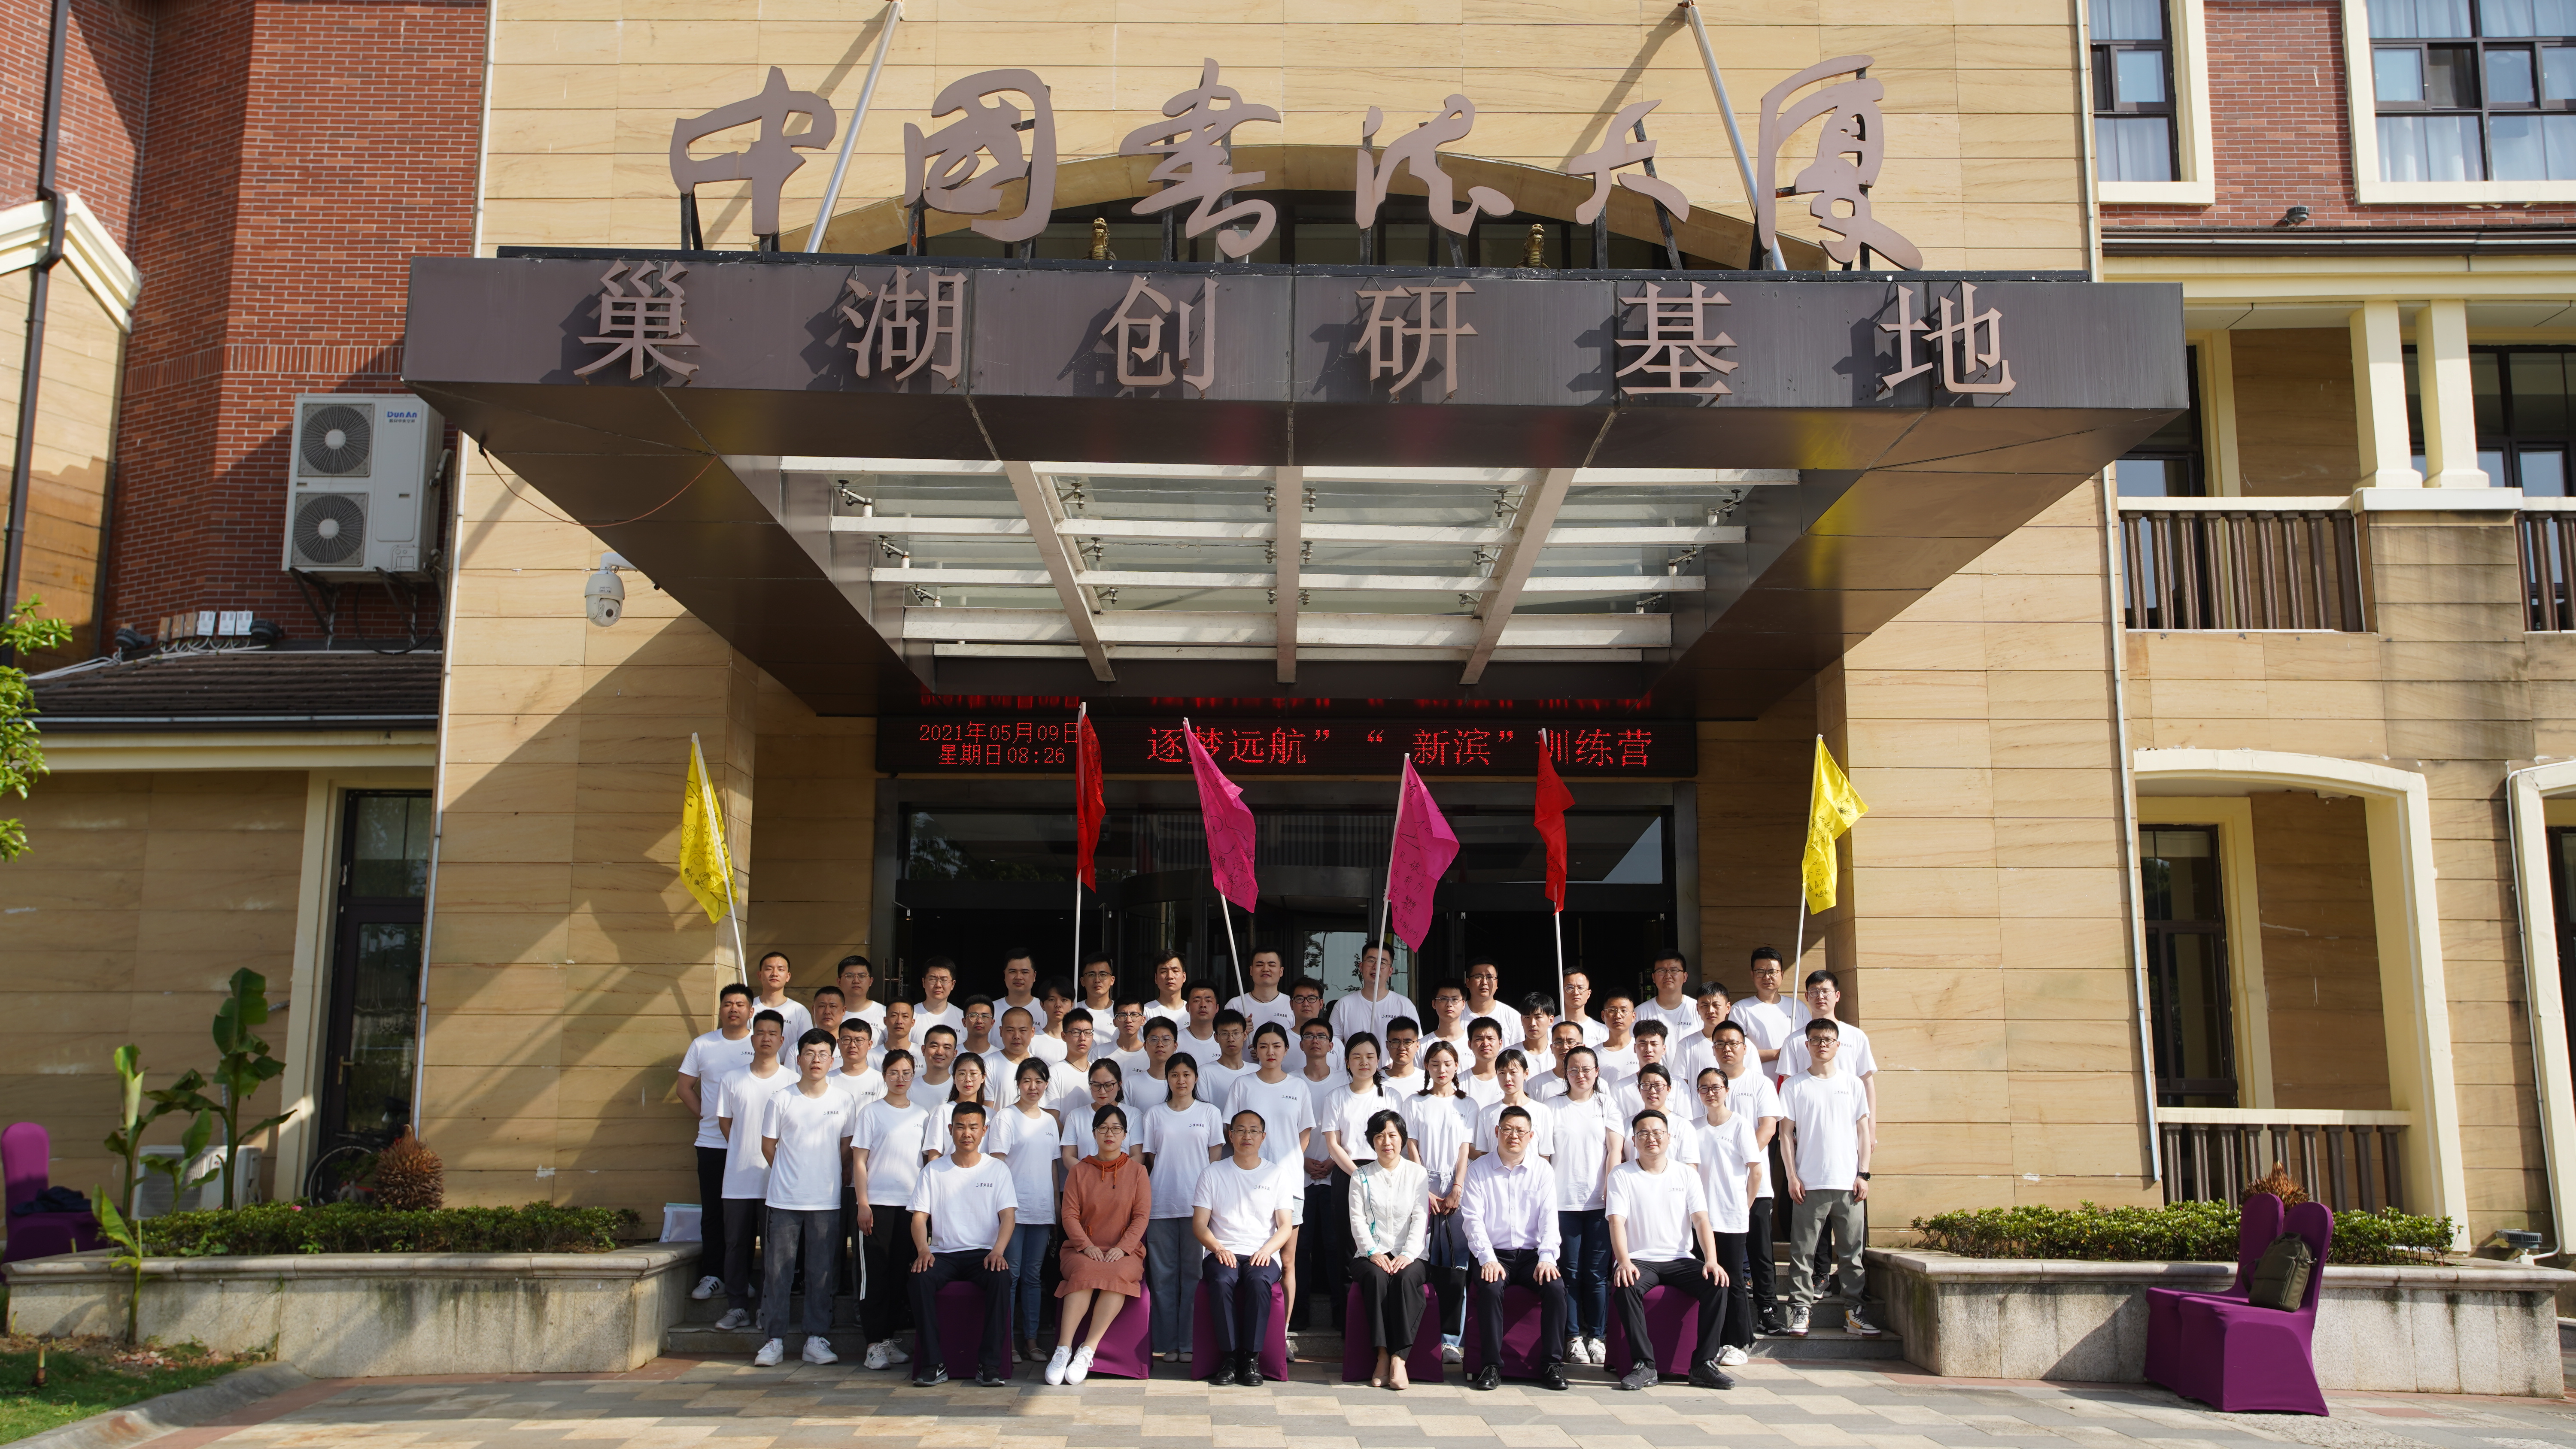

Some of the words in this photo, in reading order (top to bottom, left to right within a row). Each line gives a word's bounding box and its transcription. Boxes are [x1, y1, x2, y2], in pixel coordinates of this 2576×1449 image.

[573, 259, 2017, 397] 巢湖创研基地
[919, 721, 1078, 743] 2021年05月09日
